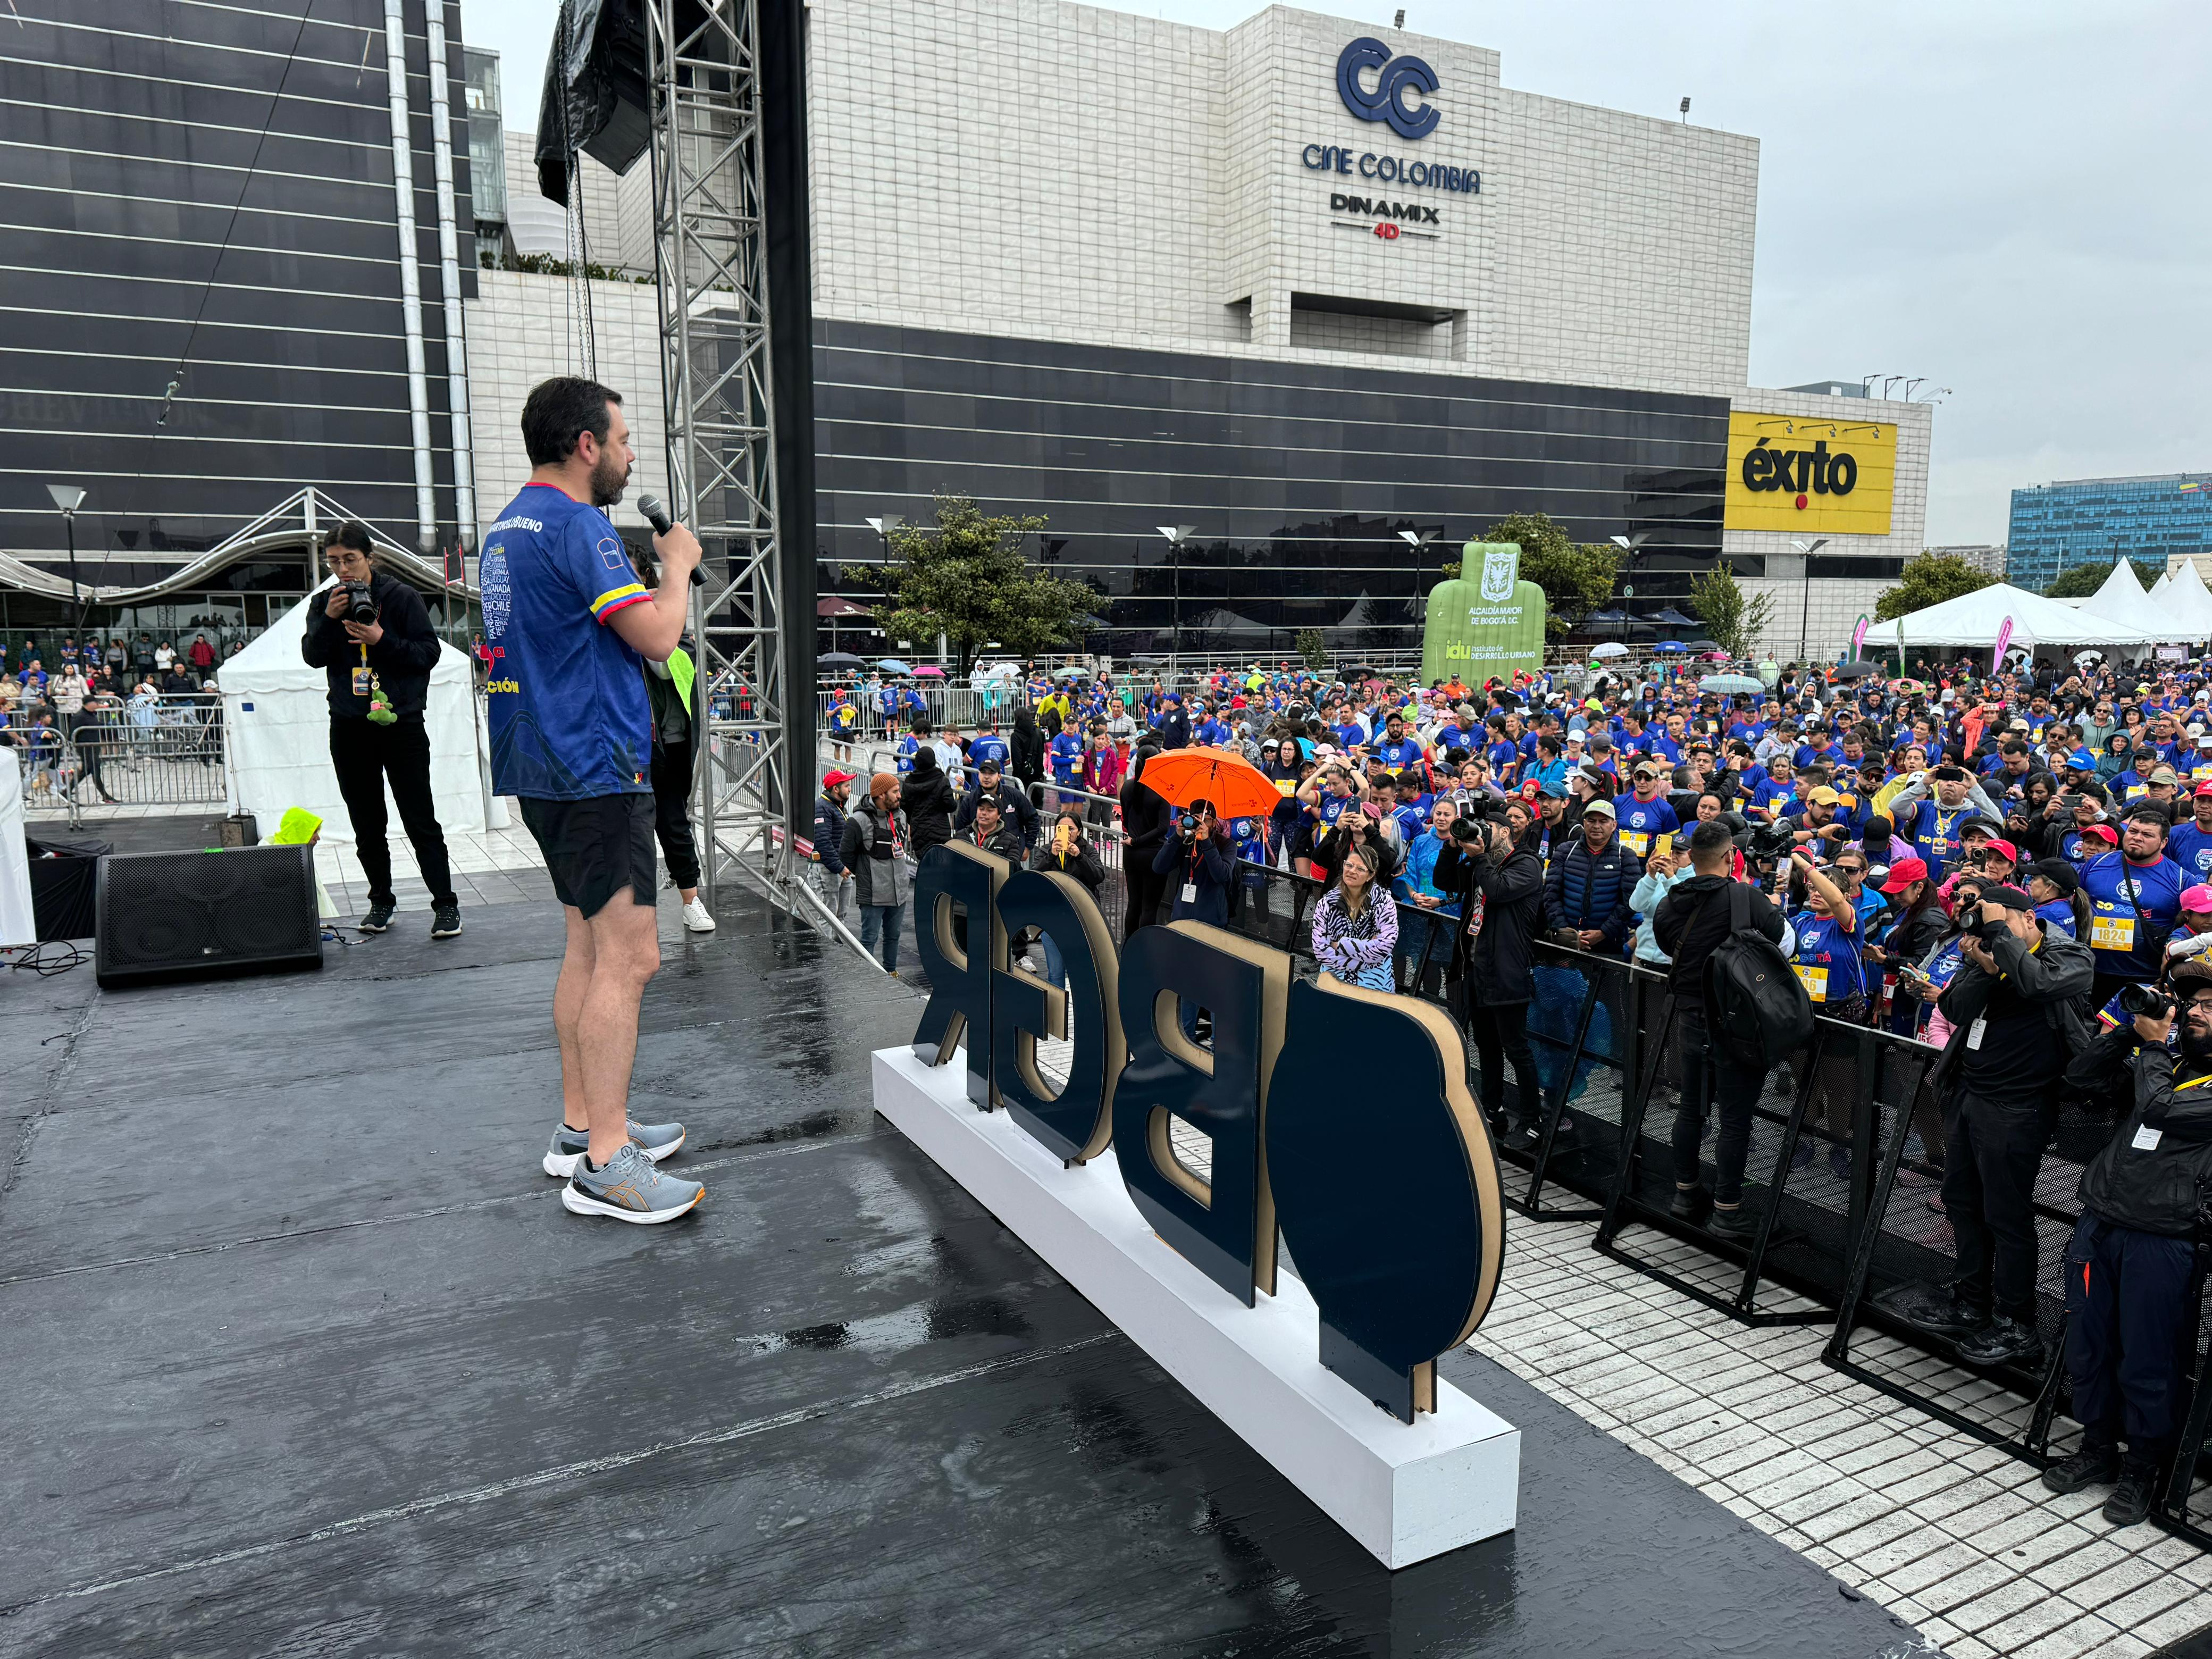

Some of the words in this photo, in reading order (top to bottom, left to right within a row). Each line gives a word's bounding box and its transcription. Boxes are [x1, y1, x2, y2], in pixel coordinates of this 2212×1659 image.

[1303, 144, 1353, 174] CINE
[1359, 153, 1480, 194] COLOMBIA
[1330, 193, 1440, 223] DINAMIX
[1374, 222, 1400, 239] 4D
[1742, 437, 1857, 510] éxito
[491, 600, 511, 612] CHILE
[1468, 605, 1499, 615] ALCALDÍA
[493, 616, 502, 636] PERU
[1480, 615, 1507, 625] BOGOTÁ
[1445, 639, 1471, 660] idu
[487, 677, 519, 693] CIÓN
[2098, 928, 2126, 942] 1824
